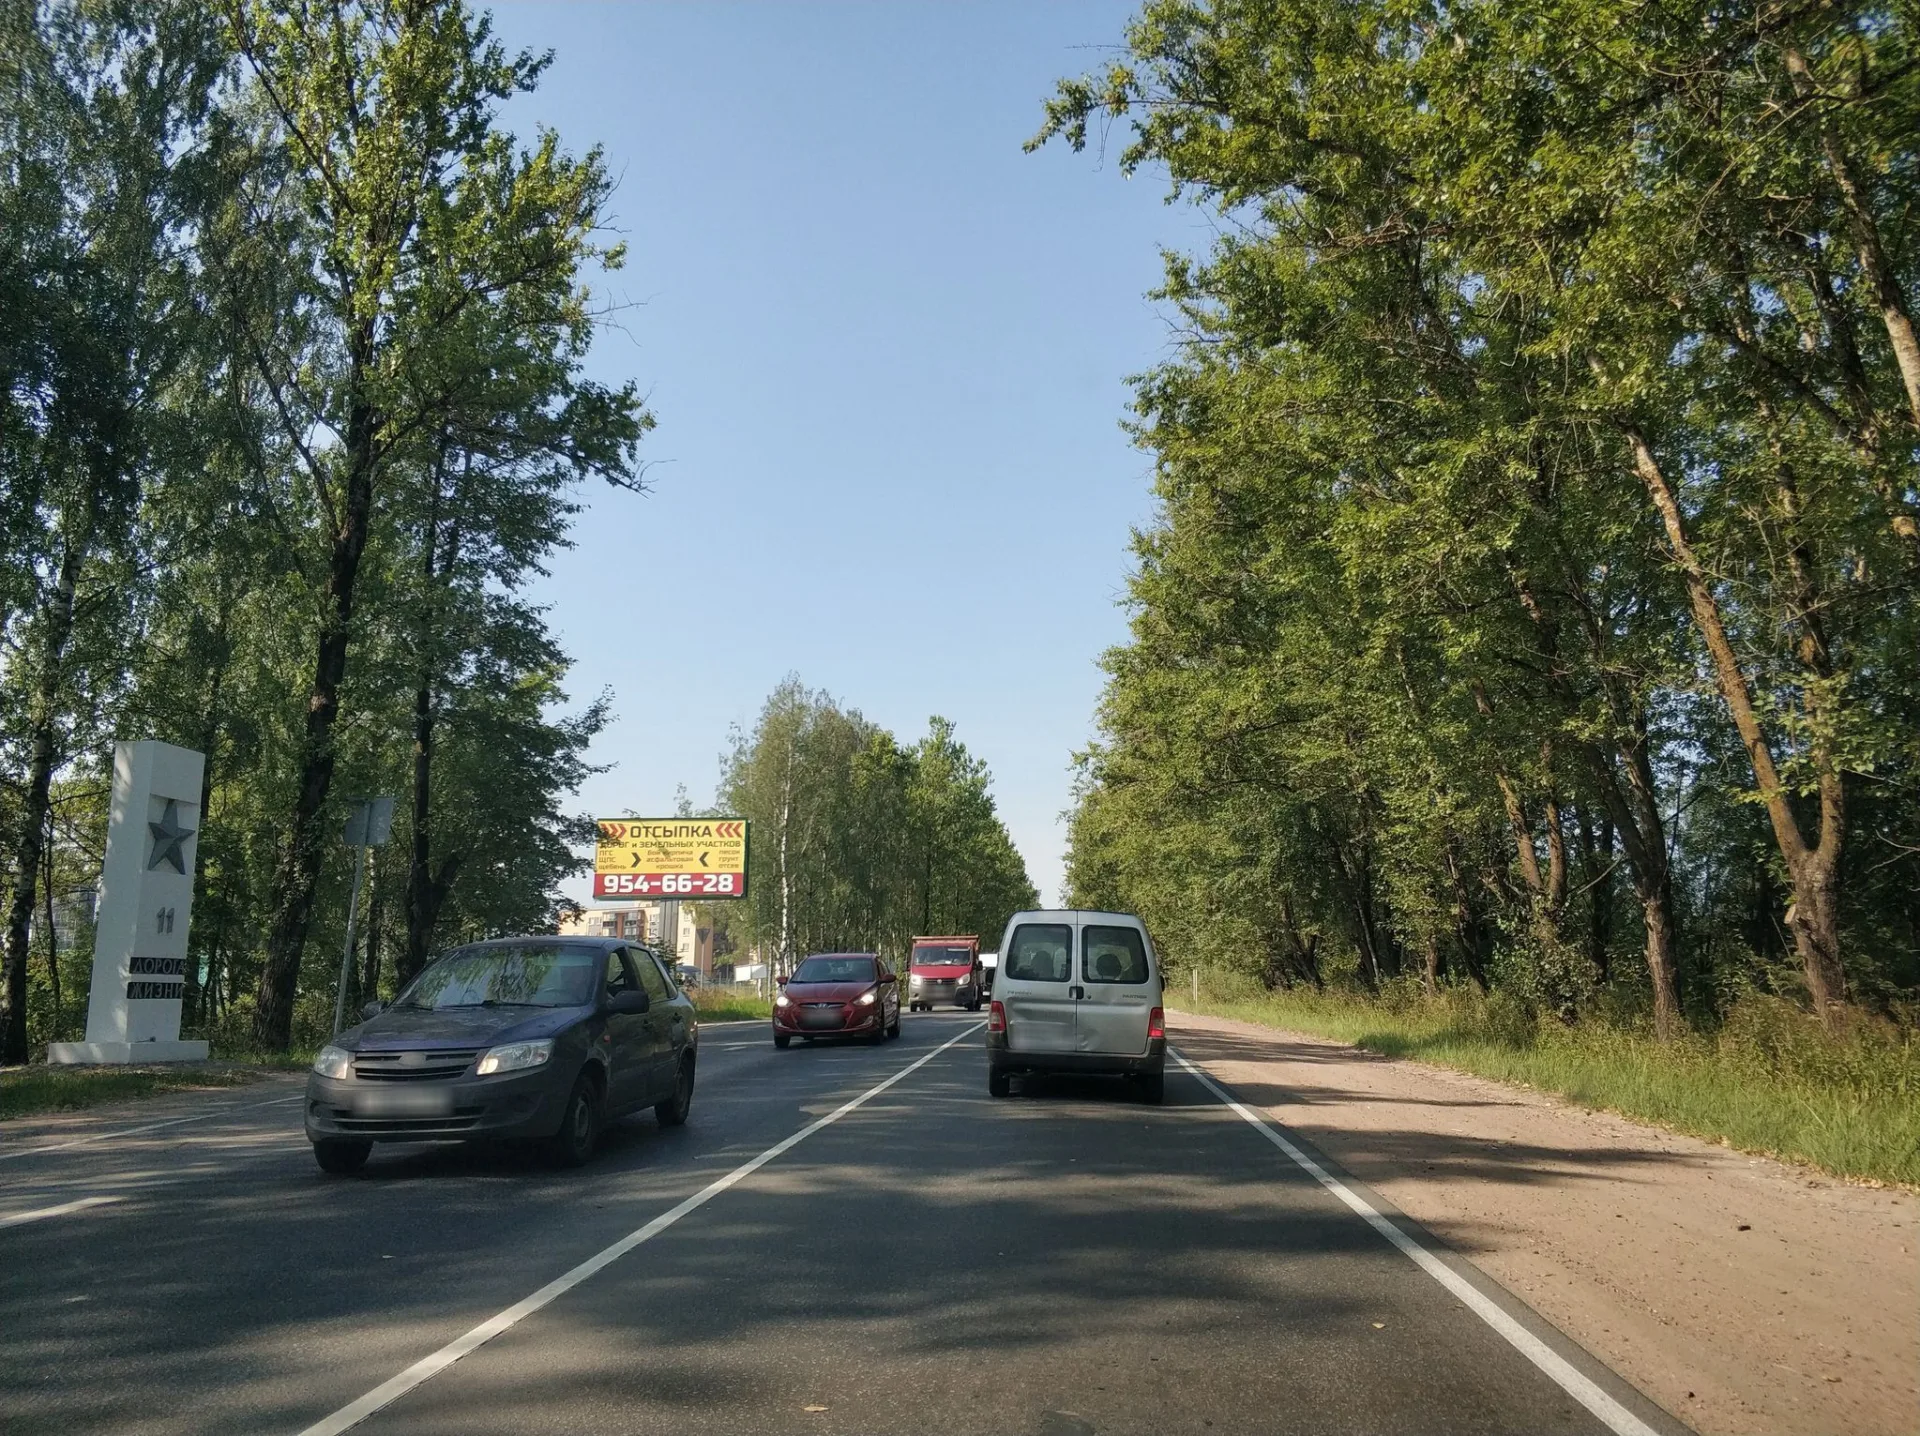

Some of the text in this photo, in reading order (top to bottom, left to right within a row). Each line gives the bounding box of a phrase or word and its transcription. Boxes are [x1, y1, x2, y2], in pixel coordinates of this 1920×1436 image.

[630, 825, 712, 838] ОТСЫПКА
[696, 840, 741, 848] УЧАСТКОВ
[603, 874, 734, 893] 954-66-28
[156, 906, 175, 934] 11
[133, 958, 186, 975] ДОРОГА
[130, 983, 185, 999] ЖИЗНИ
